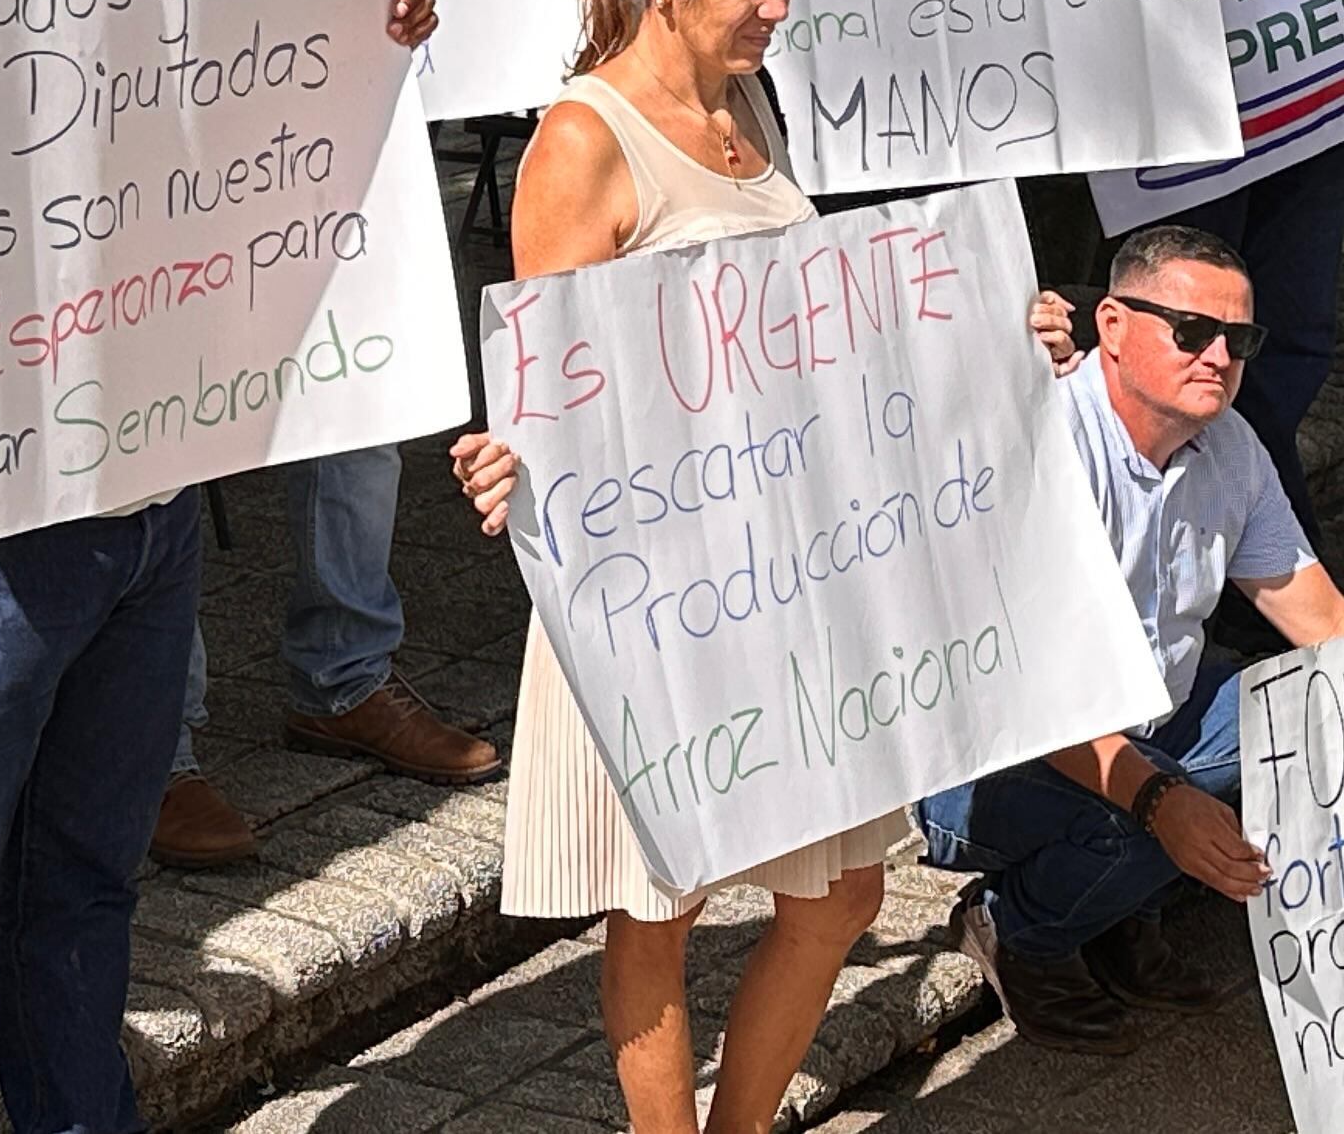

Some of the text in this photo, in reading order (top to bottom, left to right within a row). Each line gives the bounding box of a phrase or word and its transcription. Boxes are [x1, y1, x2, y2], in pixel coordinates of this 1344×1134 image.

[4, 20, 331, 157] Diputadas
[808, 50, 1060, 171] MANOS
[42, 179, 145, 252] son
[166, 122, 335, 220] nuestra
[247, 211, 369, 312] para
[53, 310, 395, 478] Sembrando
[506, 226, 960, 425] Es URGENTE
[542, 373, 916, 566] rescatar la
[567, 439, 995, 657] Producción de
[621, 565, 1024, 815] Arroz Nacional
